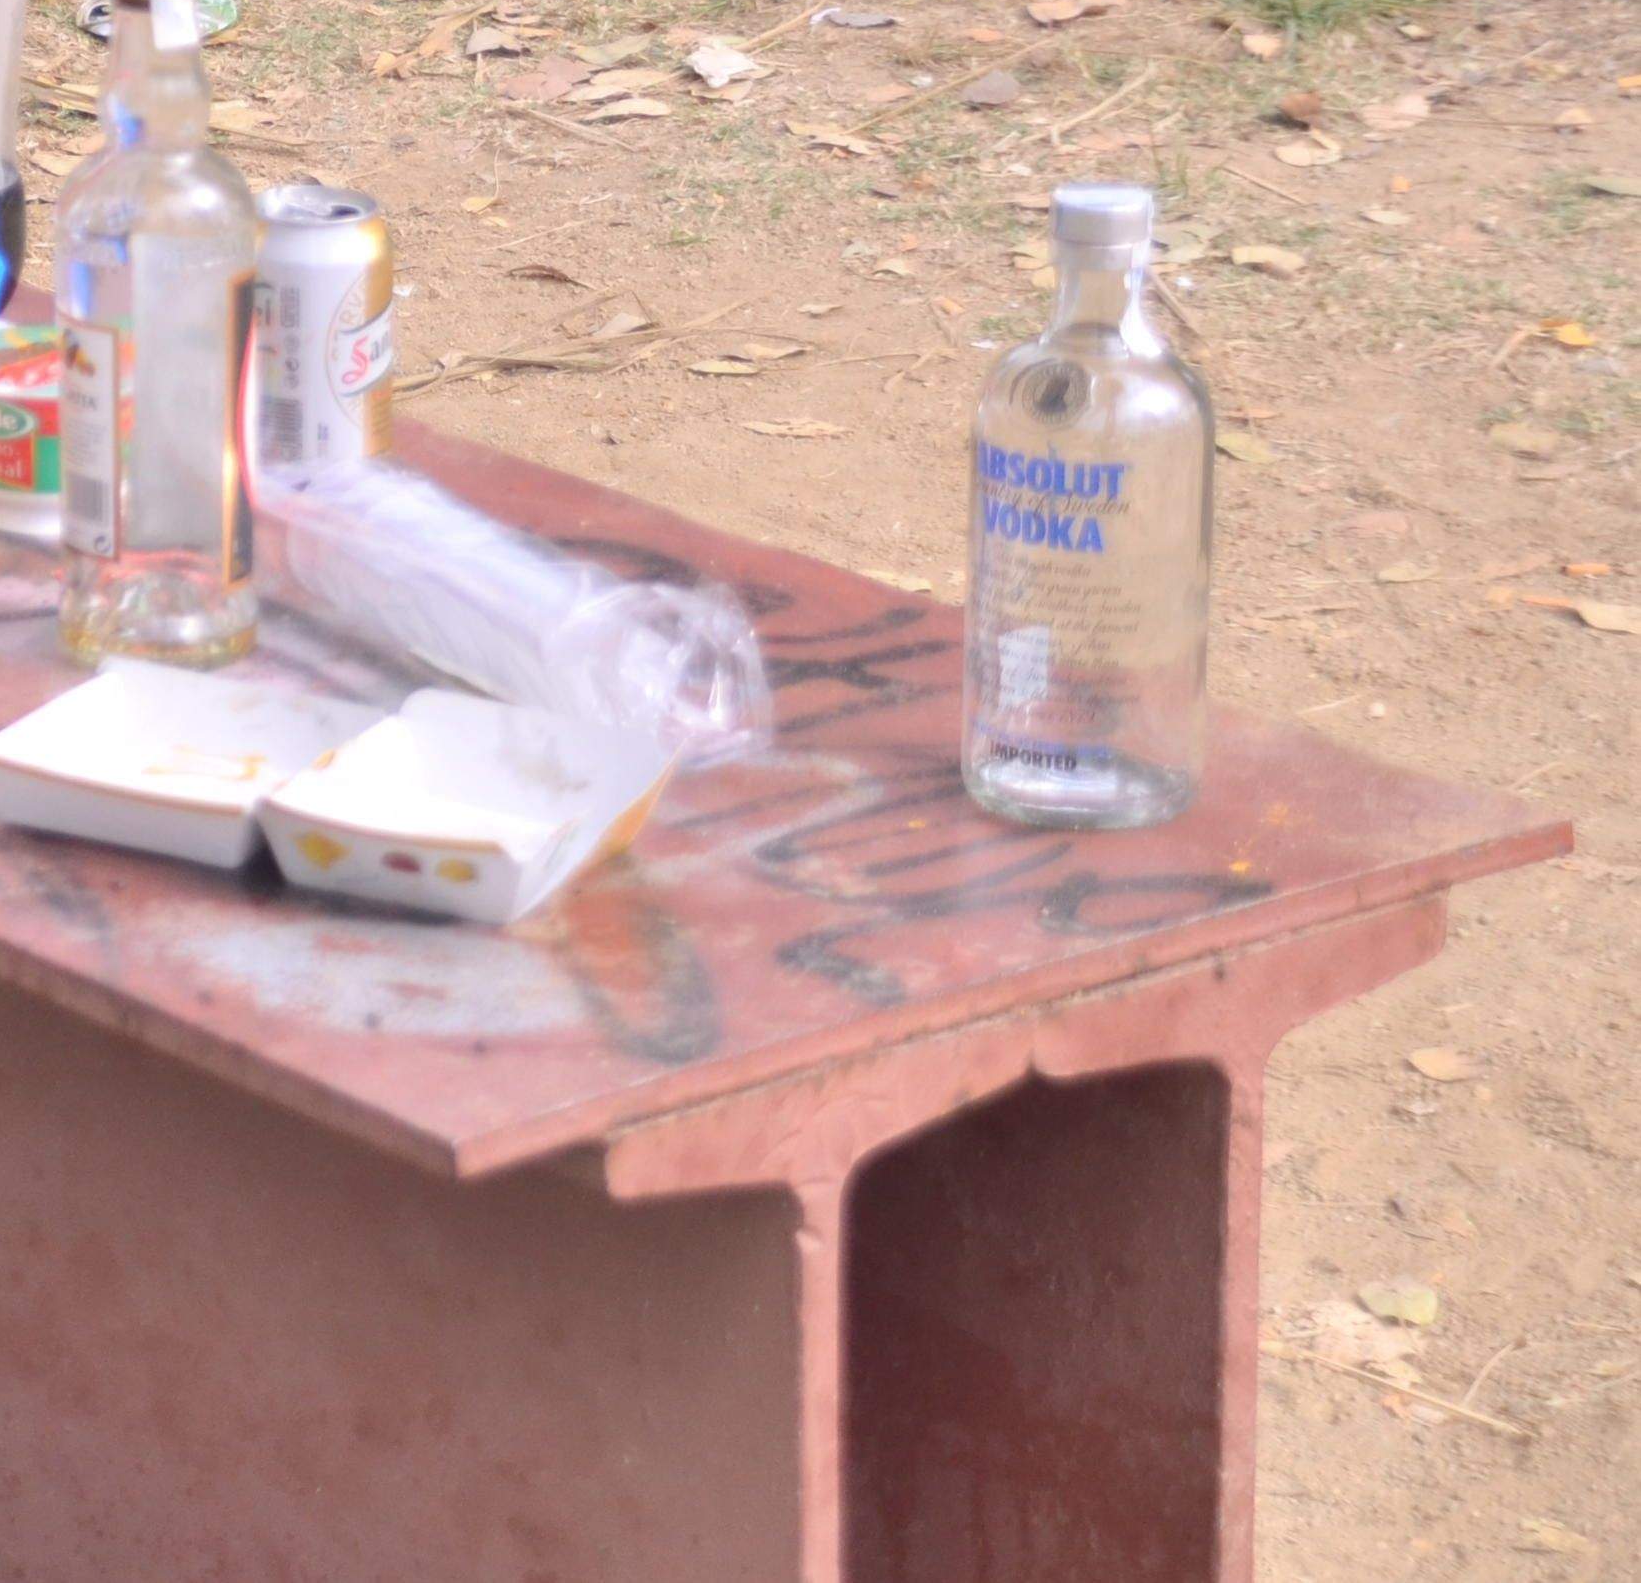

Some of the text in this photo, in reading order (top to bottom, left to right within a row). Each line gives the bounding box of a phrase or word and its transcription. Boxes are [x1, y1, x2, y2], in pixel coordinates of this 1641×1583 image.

[977, 440, 1126, 500] ABSOLUT
[983, 493, 1104, 554] VODKA
[989, 740, 1078, 772] IMPORTED
